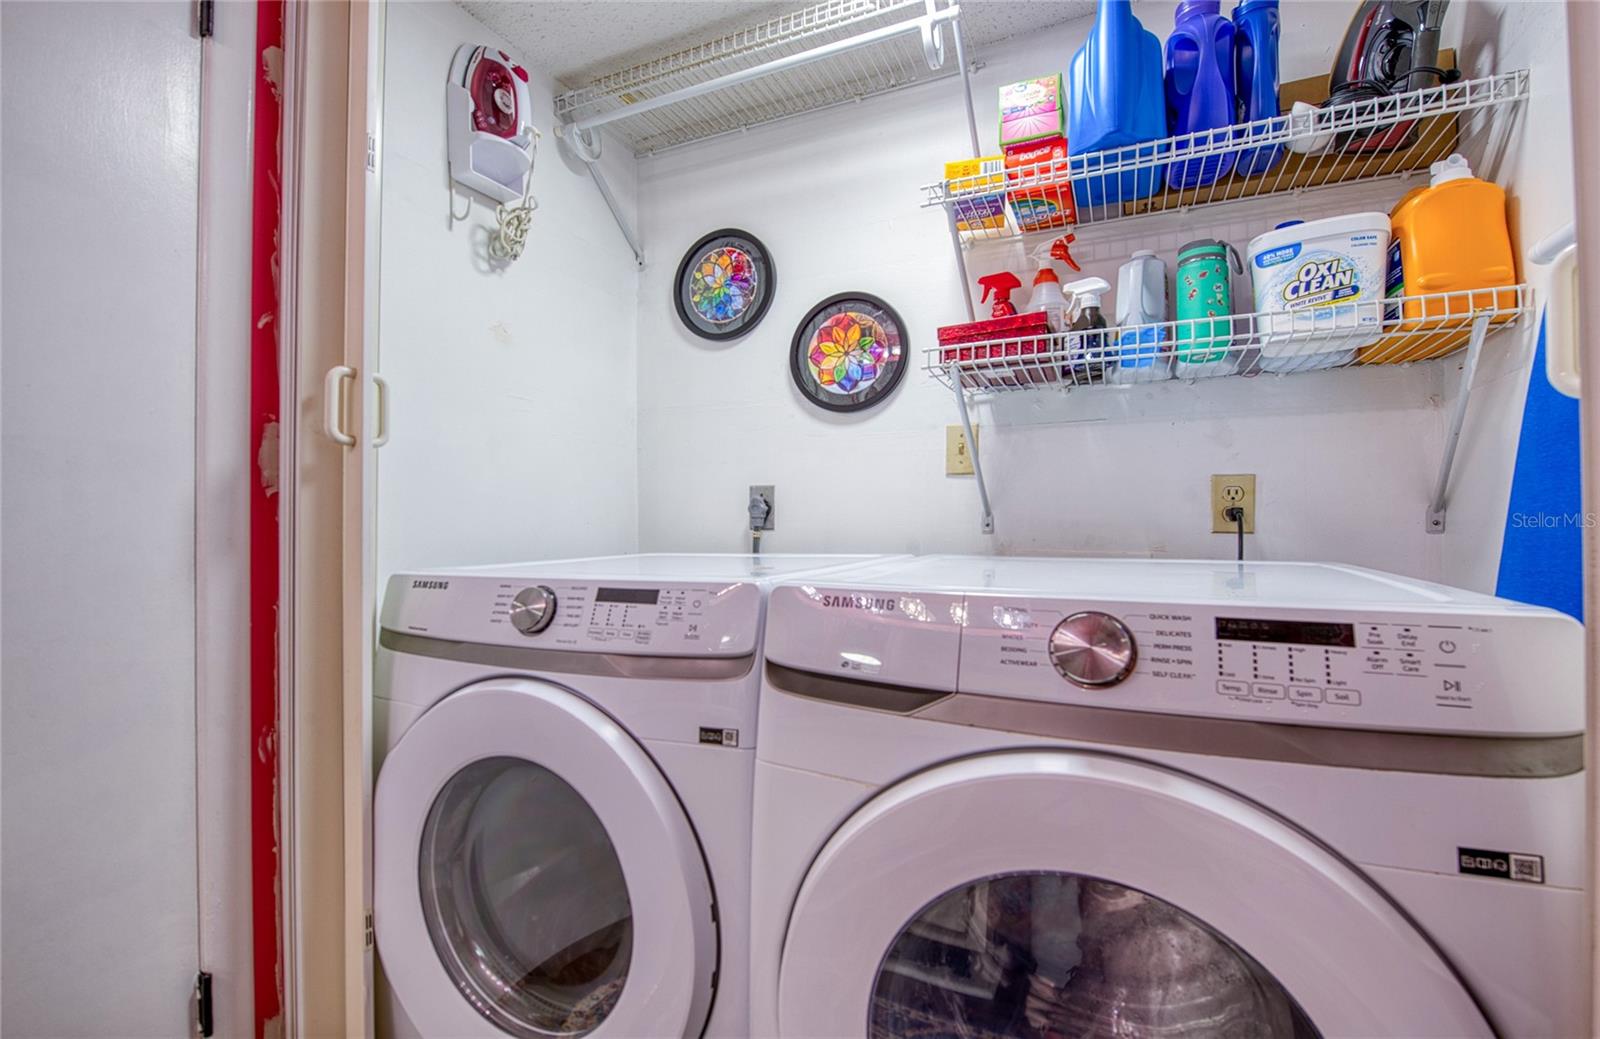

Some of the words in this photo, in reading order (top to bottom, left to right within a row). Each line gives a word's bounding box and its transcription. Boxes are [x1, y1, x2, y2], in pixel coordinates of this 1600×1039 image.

[1299, 259, 1339, 281] OXI
[1284, 270, 1353, 300] CLEAN
[1290, 298, 1307, 309] WHITE
[412, 580, 449, 590] SAMSUNG
[823, 595, 895, 611] SAMSUNG
[1155, 630, 1192, 638] DELICATES
[1397, 633, 1418, 641] Delay
[1000, 659, 1037, 667] ACTIVEWEAR
[1176, 658, 1192, 666] SPIN
[1257, 687, 1278, 695] Rinse
[1296, 690, 1313, 699] Spin
[1334, 693, 1350, 701] Soil
